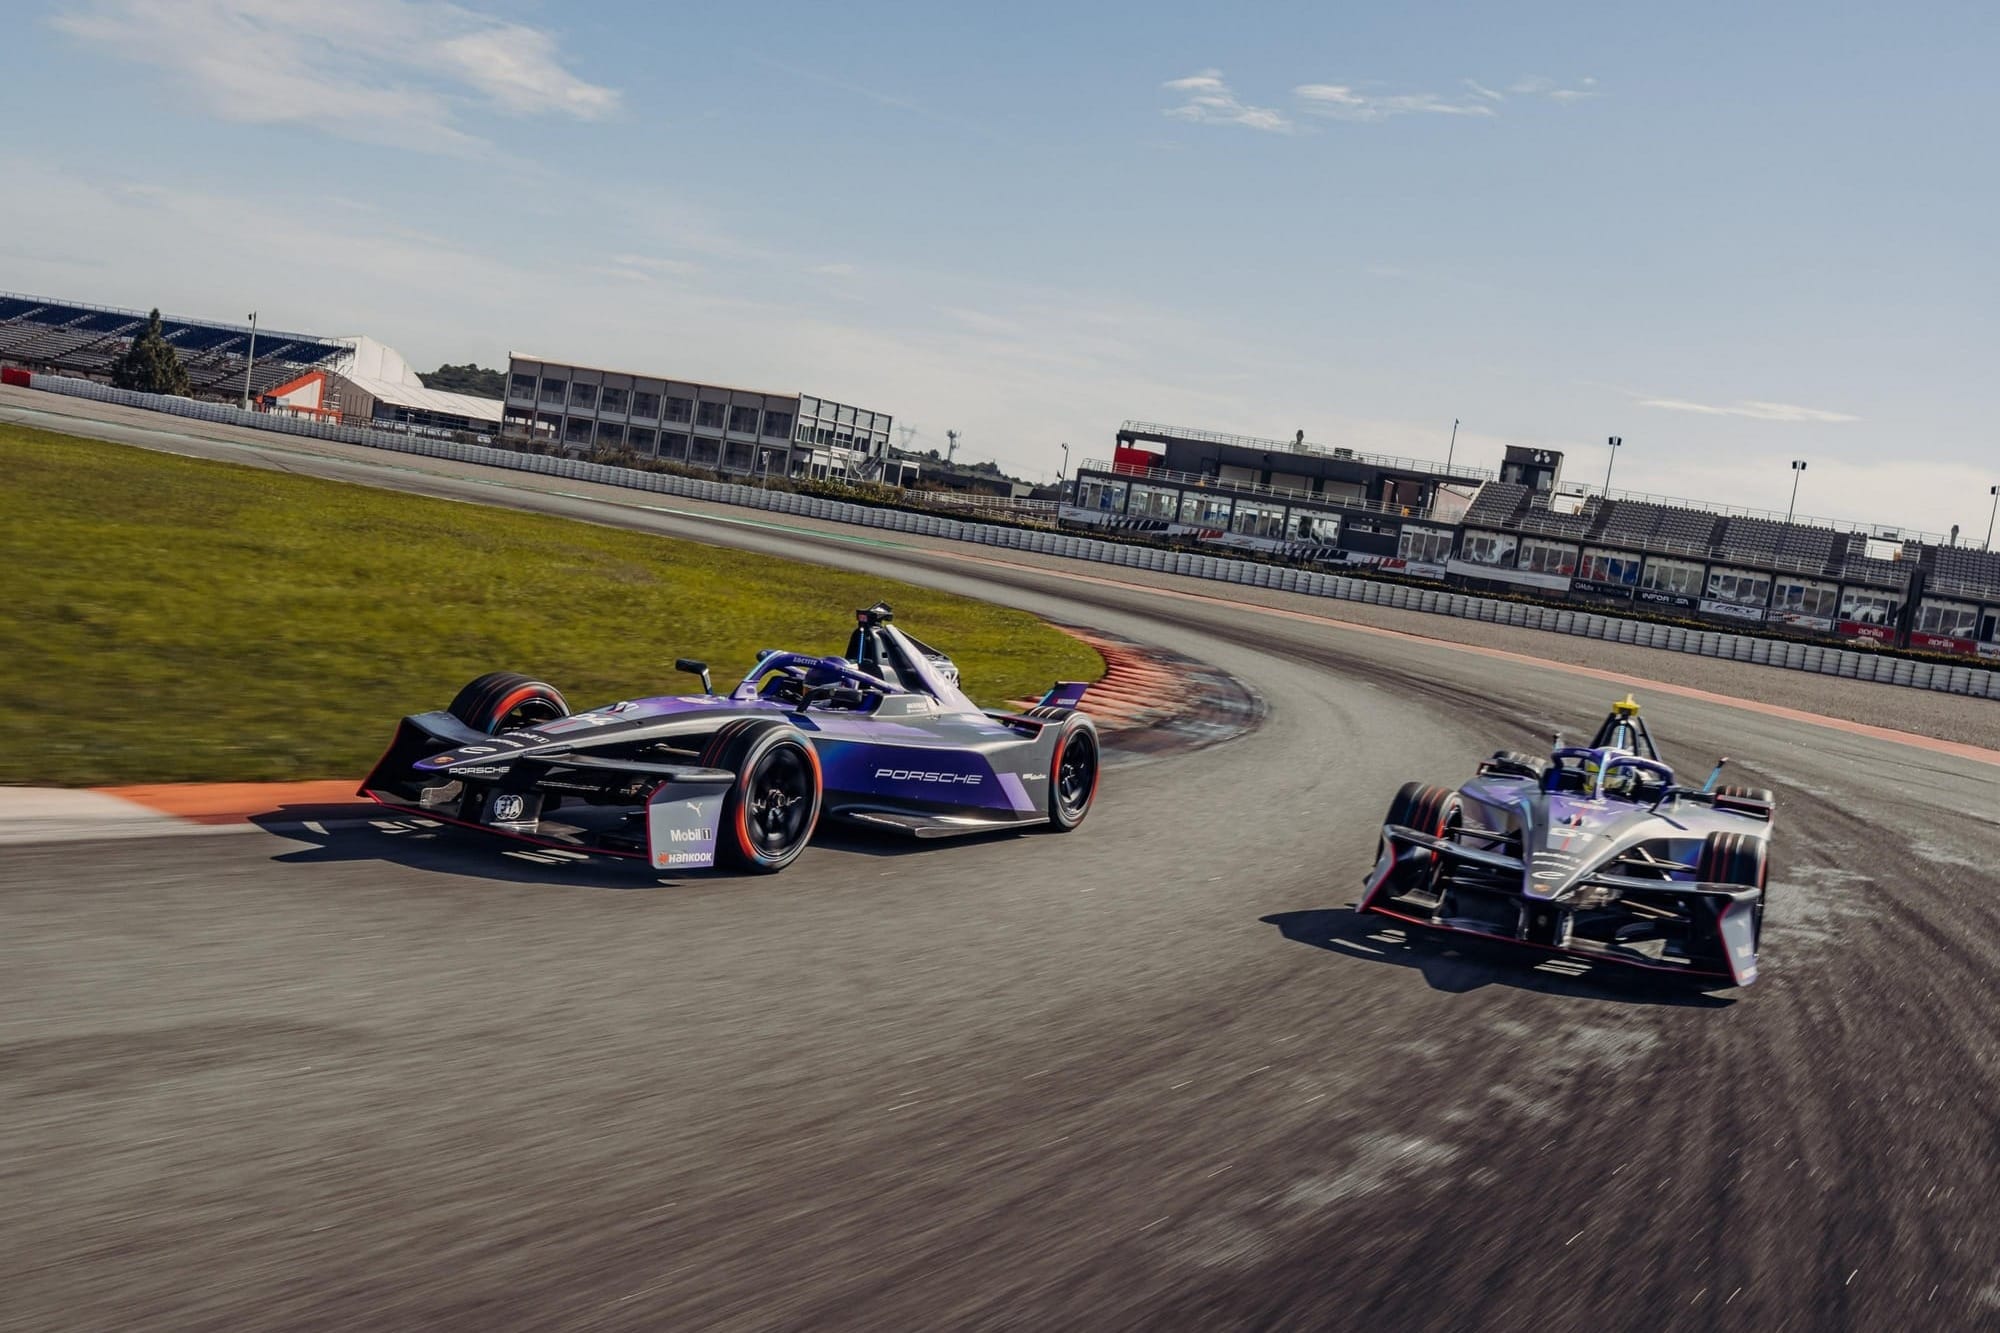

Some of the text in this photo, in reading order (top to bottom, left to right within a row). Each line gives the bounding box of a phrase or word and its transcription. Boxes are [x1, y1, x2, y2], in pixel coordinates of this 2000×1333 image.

[1857, 627, 1884, 638] aprilia
[1927, 637, 1955, 648] aprilia
[792, 656, 818, 666] LOCTITE
[449, 766, 511, 775] PORSCHE
[875, 768, 983, 785] PORSCHE
[670, 828, 701, 842] Mobil
